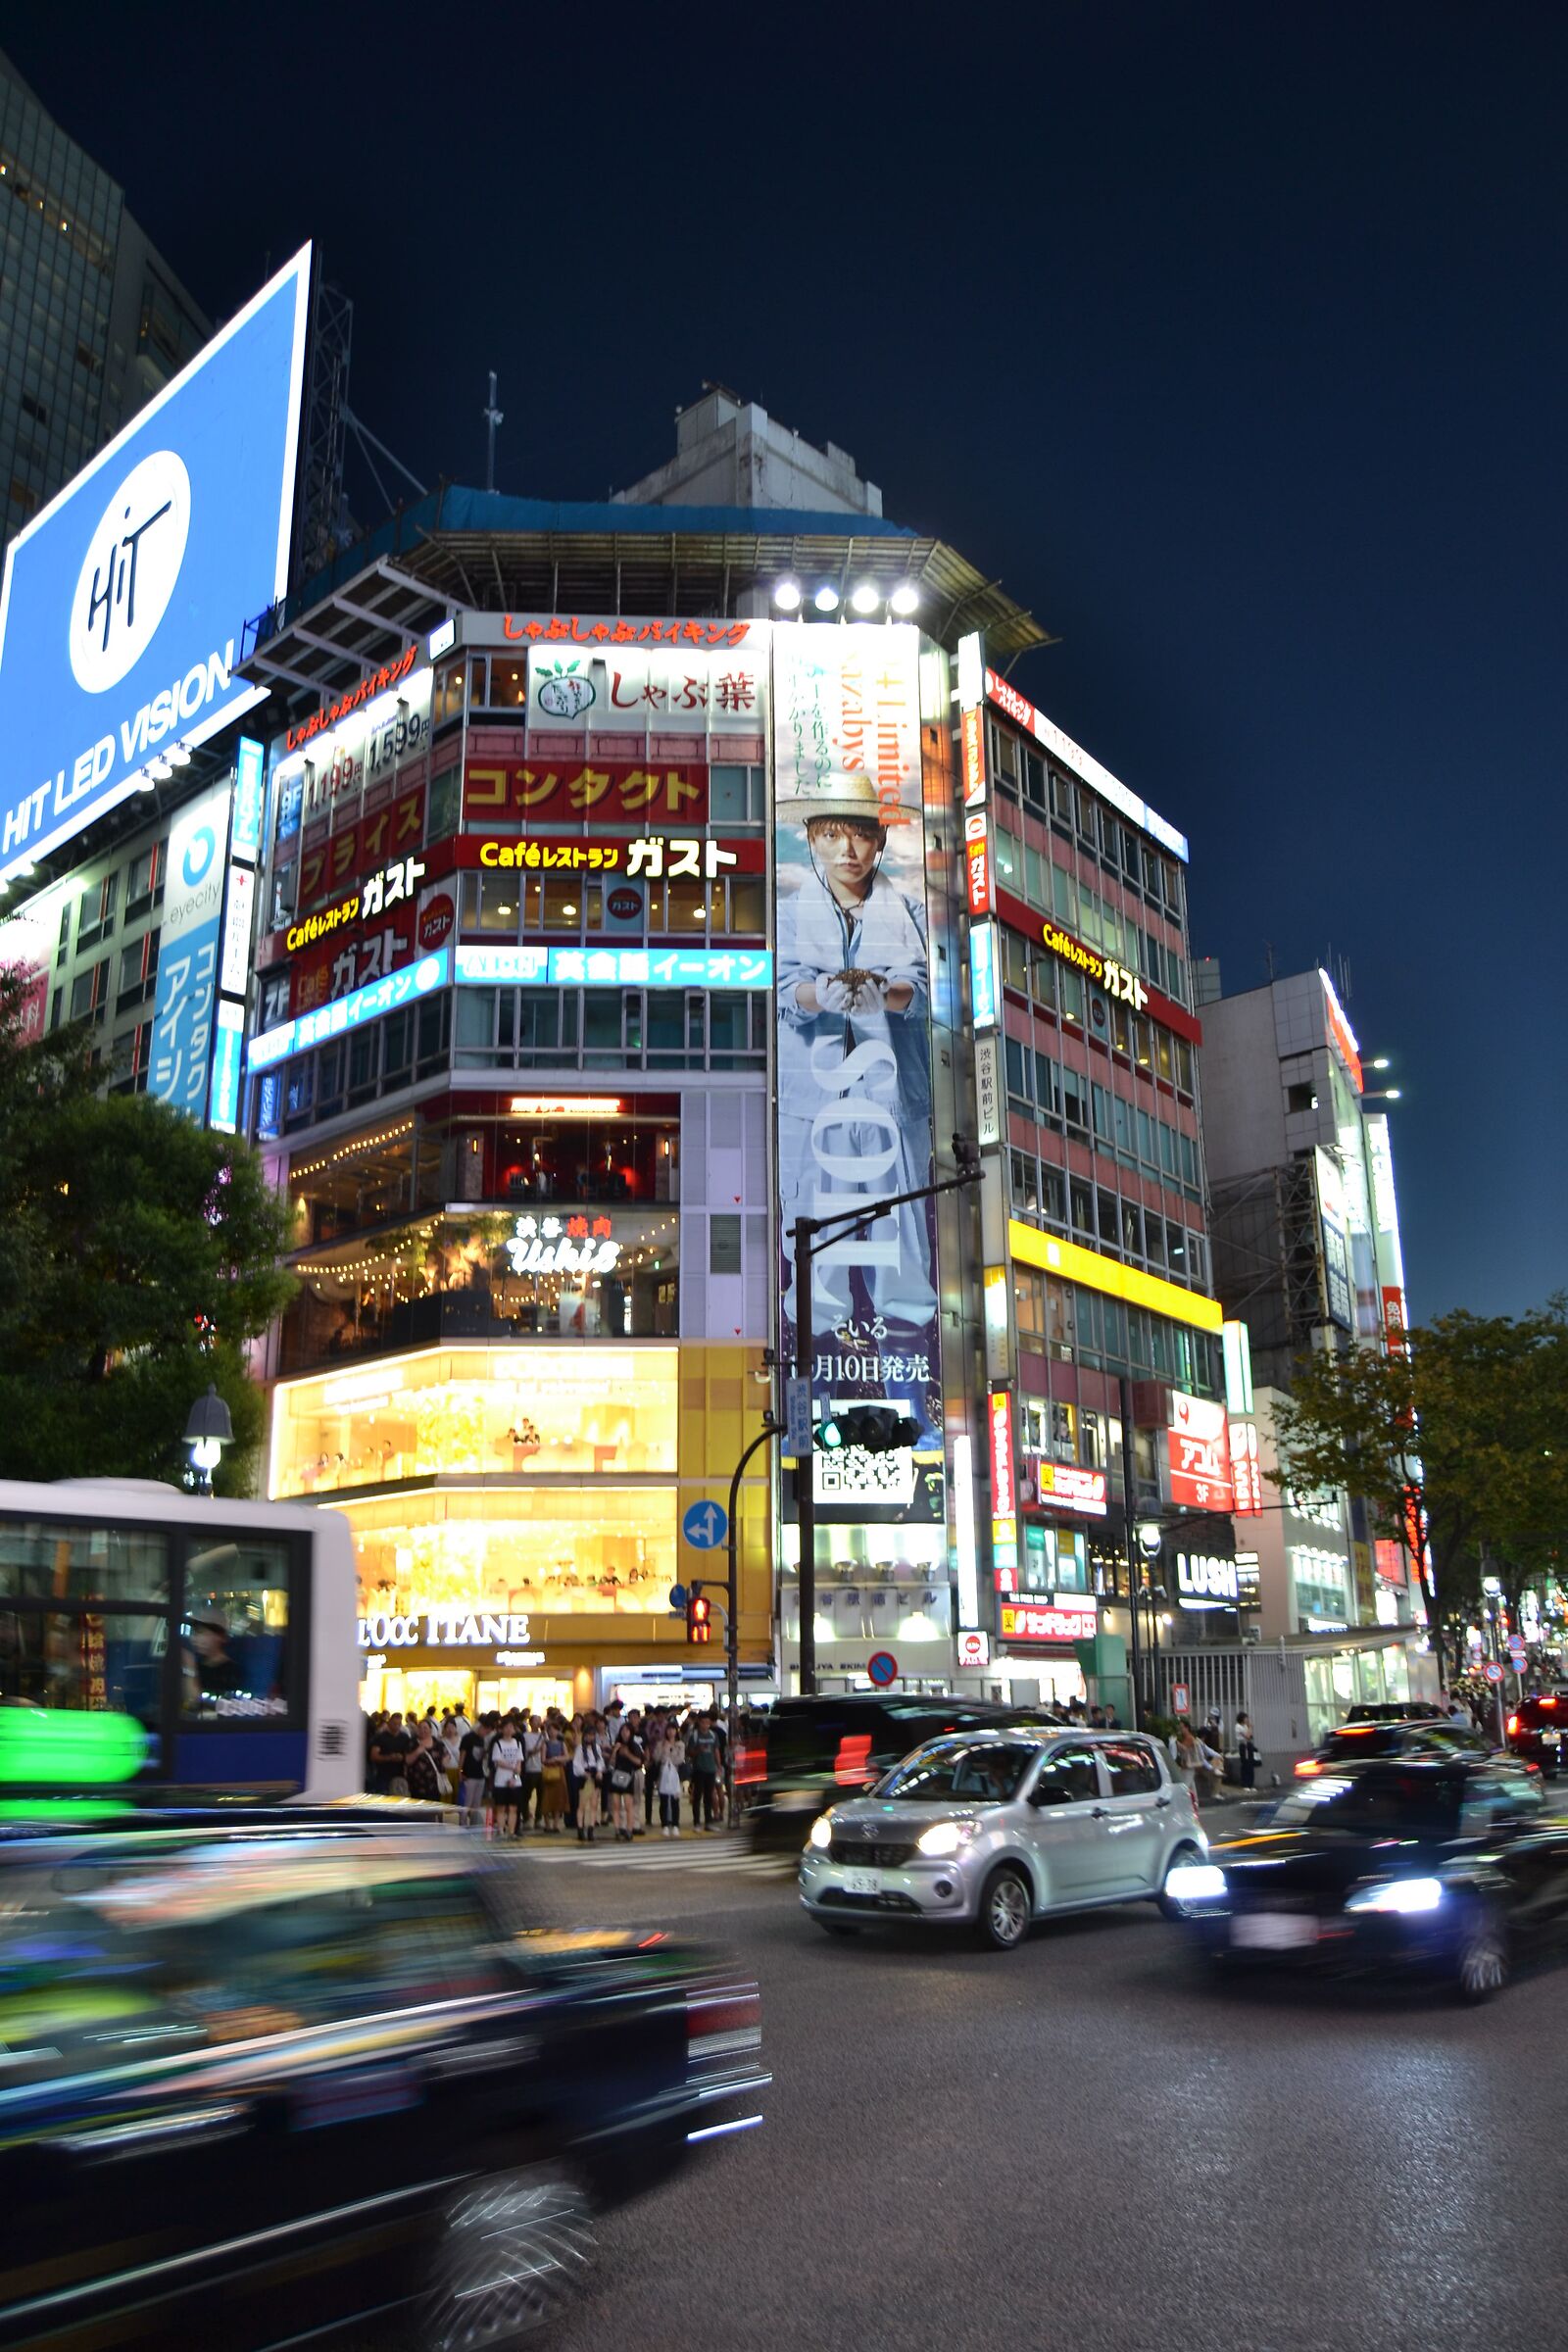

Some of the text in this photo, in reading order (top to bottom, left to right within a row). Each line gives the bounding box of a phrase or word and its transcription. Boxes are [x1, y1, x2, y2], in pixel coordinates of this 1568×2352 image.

[504, 614, 751, 646] しゃぶしゃぶバイキング
[287, 645, 417, 751] しゃぶしゃぶバイキング
[611, 671, 756, 711] しゃぶ葉
[833, 650, 873, 771] azabys
[3, 637, 236, 855] HIT LED VISION
[466, 768, 700, 811] コンタクト
[626, 837, 737, 877] ガスト
[170, 883, 221, 922] eyecity
[362, 856, 425, 919] ガスト
[970, 855, 986, 906] ガスト
[1103, 958, 1148, 1010] ガスト
[156, 956, 191, 1115] アイシ
[186, 941, 216, 1127] コンタク
[980, 1048, 994, 1135] 渋谷駅前ビル
[831, 1314, 888, 1340] そいる
[789, 1353, 930, 1383] 1月10日発売
[1180, 1438, 1220, 1477] アコム
[1195, 1482, 1209, 1504] 3F
[1176, 1552, 1238, 1598] LUSH
